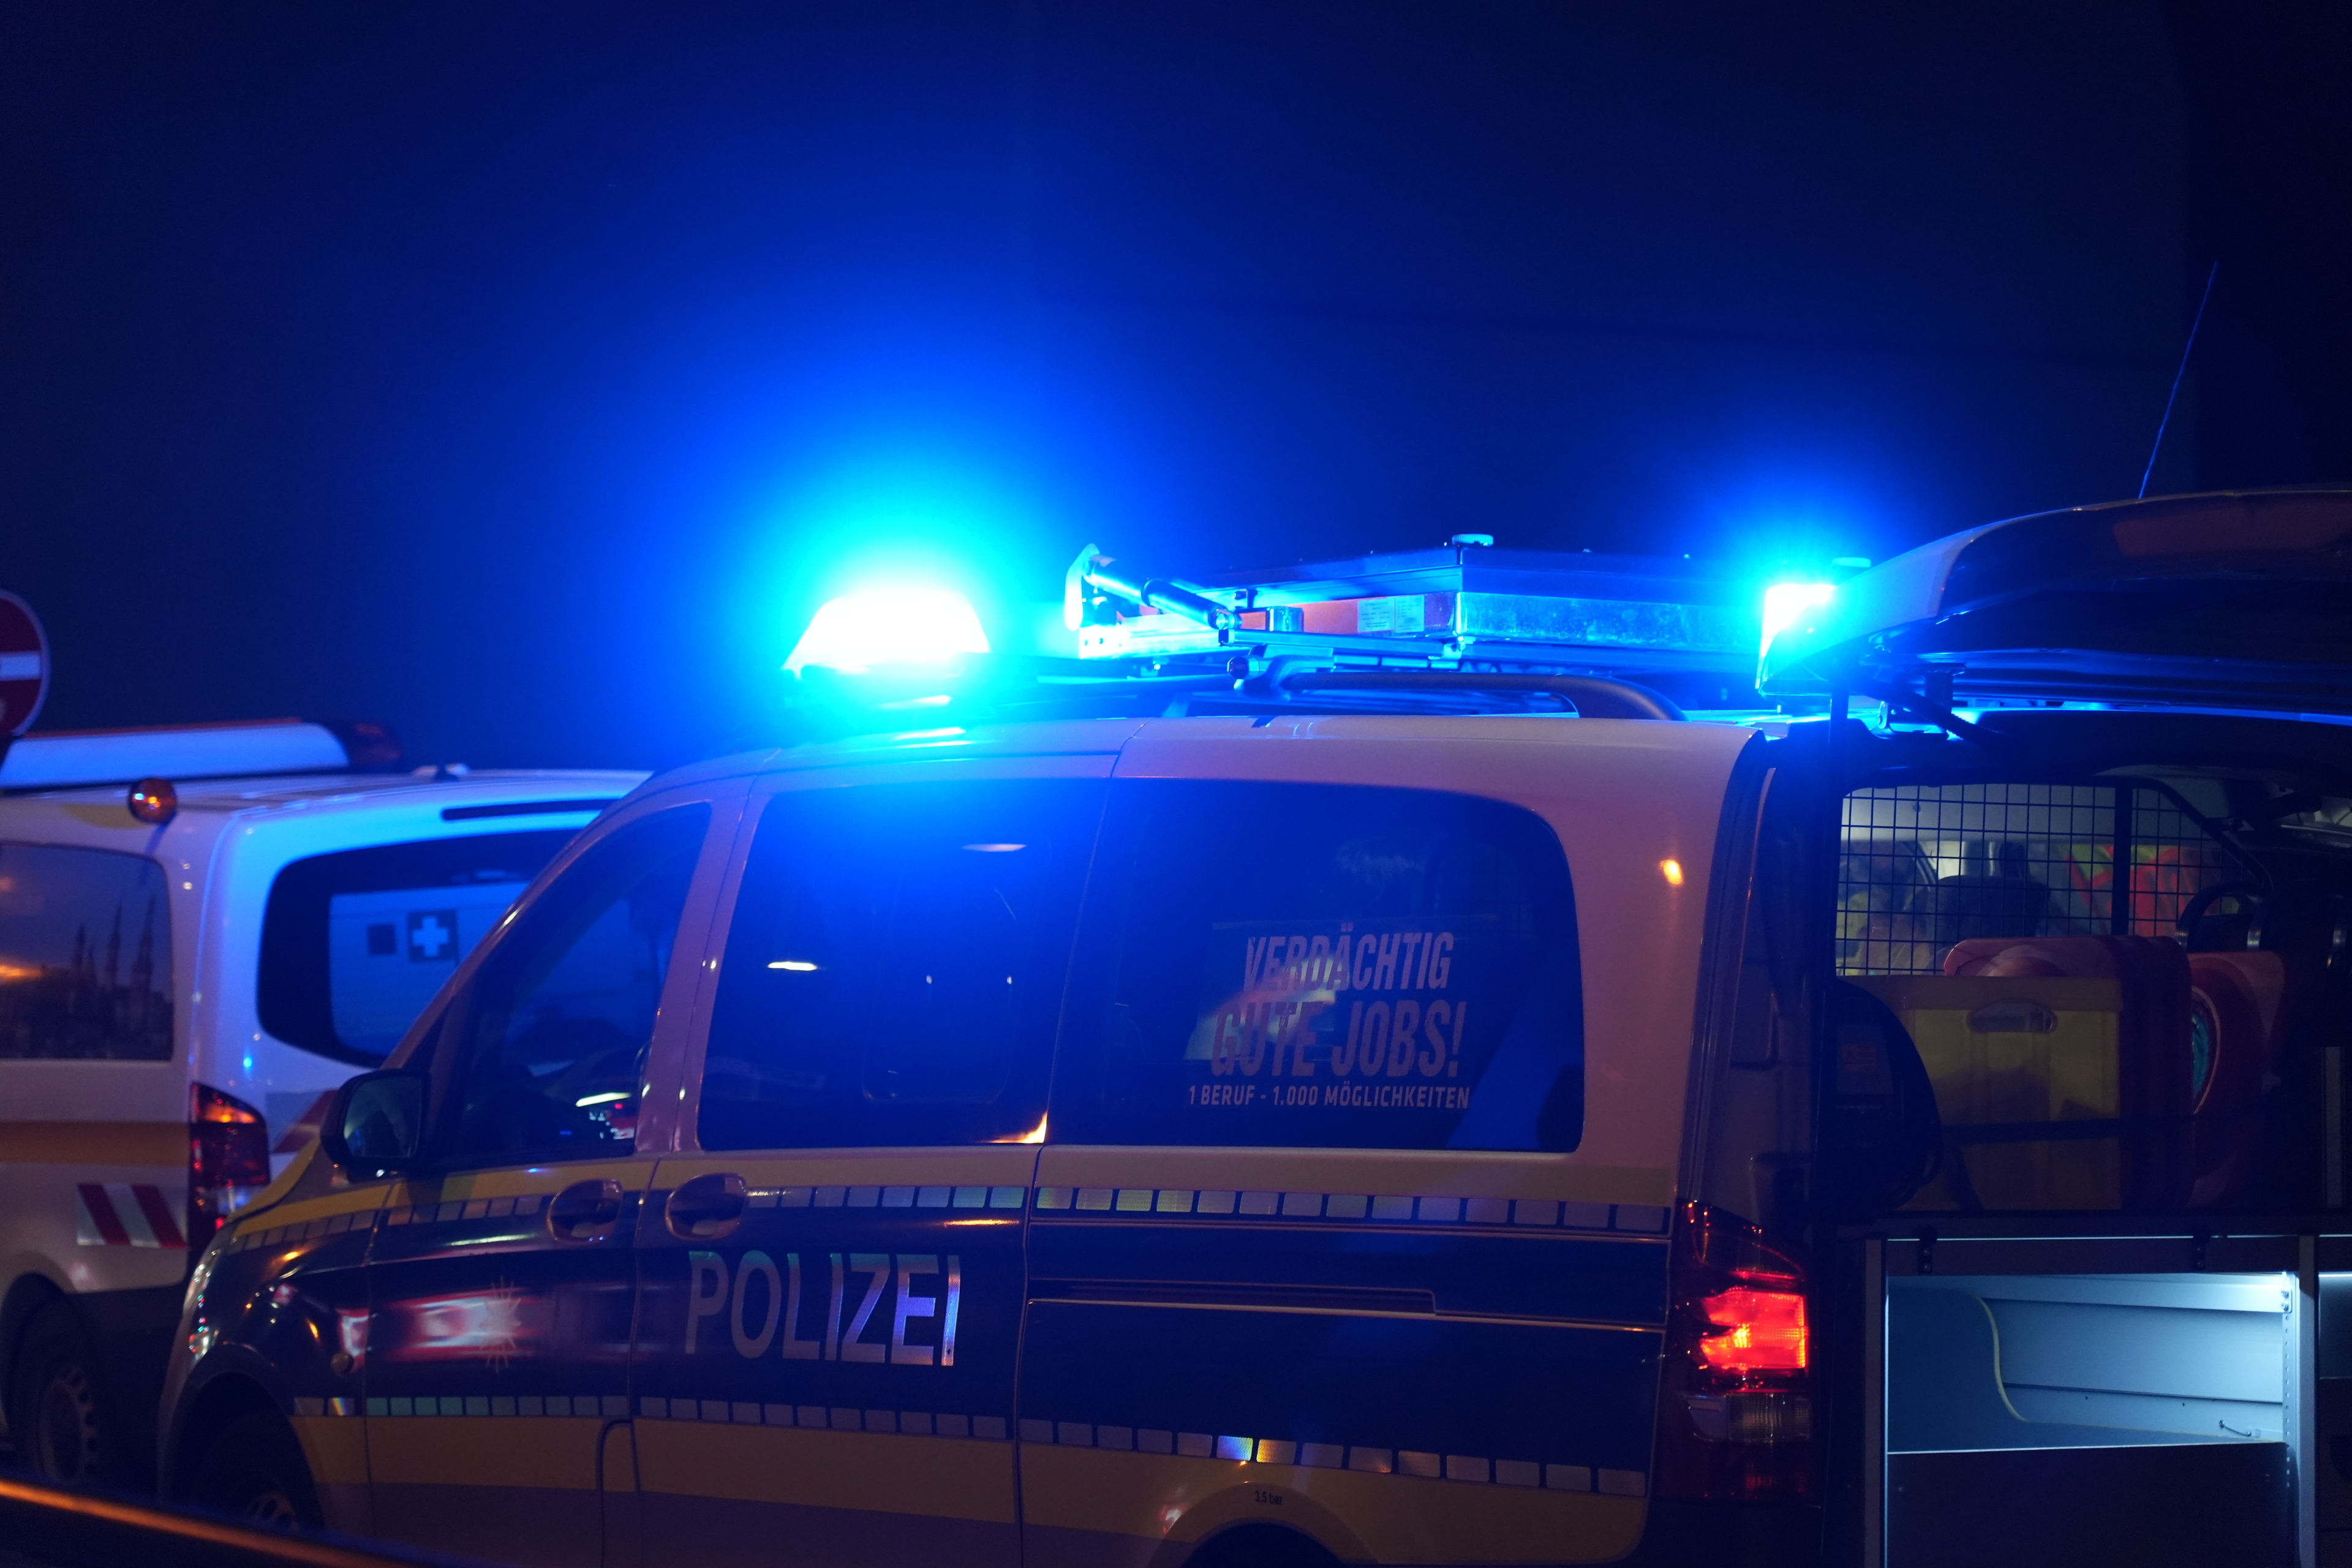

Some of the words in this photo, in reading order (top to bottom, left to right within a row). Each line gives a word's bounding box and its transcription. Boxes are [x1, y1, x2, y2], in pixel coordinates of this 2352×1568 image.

[1243, 922, 1454, 991] VERDÄCHTIG
[1211, 1001, 1324, 1077] GUTE
[1332, 1000, 1466, 1077] JOBS!
[1189, 1086, 1196, 1105] 1
[1200, 1085, 1256, 1106] BERUF
[1273, 1087, 1318, 1106] 1.000
[1324, 1081, 1470, 1109] MÖGLICHKEITEN
[685, 1250, 960, 1366] POLIZEI
[1255, 1490, 1268, 1504] 3,5
[1269, 1493, 1283, 1505] bar
